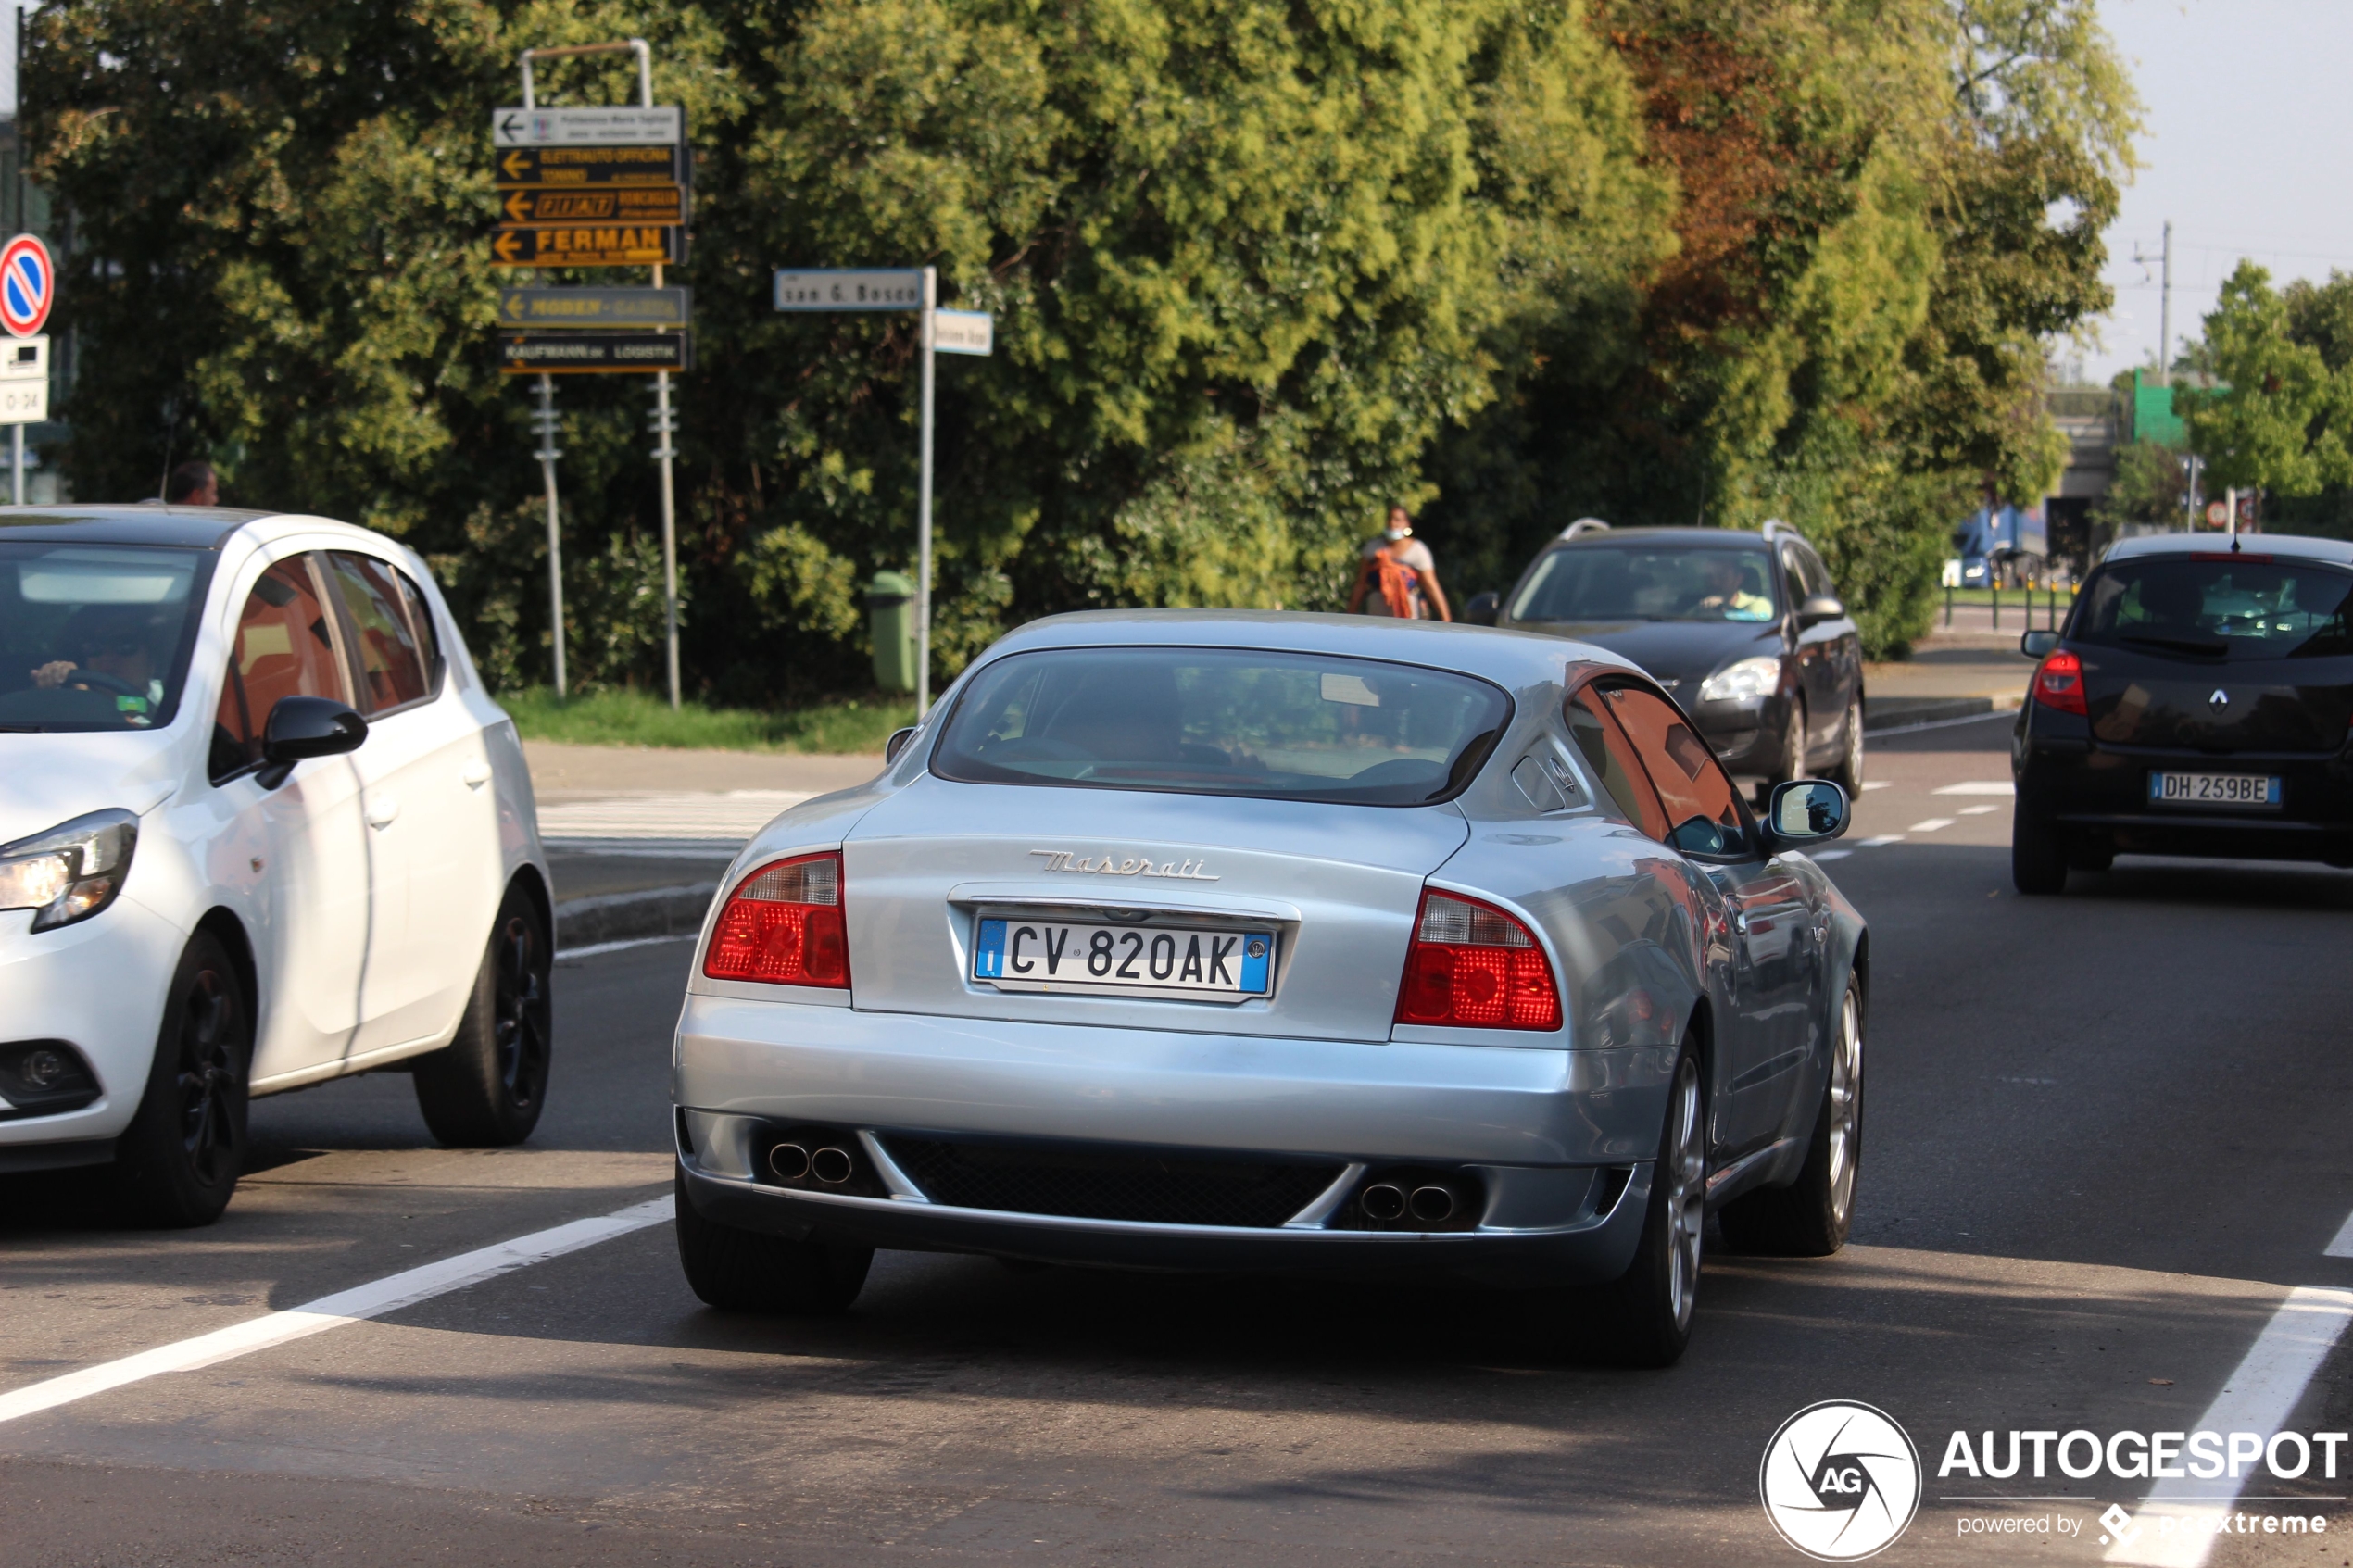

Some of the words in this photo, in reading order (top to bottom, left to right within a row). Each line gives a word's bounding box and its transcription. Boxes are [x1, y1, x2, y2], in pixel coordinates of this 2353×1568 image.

[539, 149, 613, 164] ELETTRAUTO
[615, 148, 671, 163] OFFICINA
[540, 169, 587, 182] TONINO
[542, 196, 610, 213] FIAT
[535, 229, 661, 251] FERMAN
[857, 284, 917, 302] Bosco
[505, 344, 588, 359] KAUFMANN
[613, 344, 676, 359] LOGISTIK
[2165, 775, 2191, 797] DH
[2199, 777, 2266, 800] 259BE
[1029, 849, 1221, 881] Maserati
[1011, 926, 1068, 975] CV
[1088, 930, 1237, 985] 820AK
